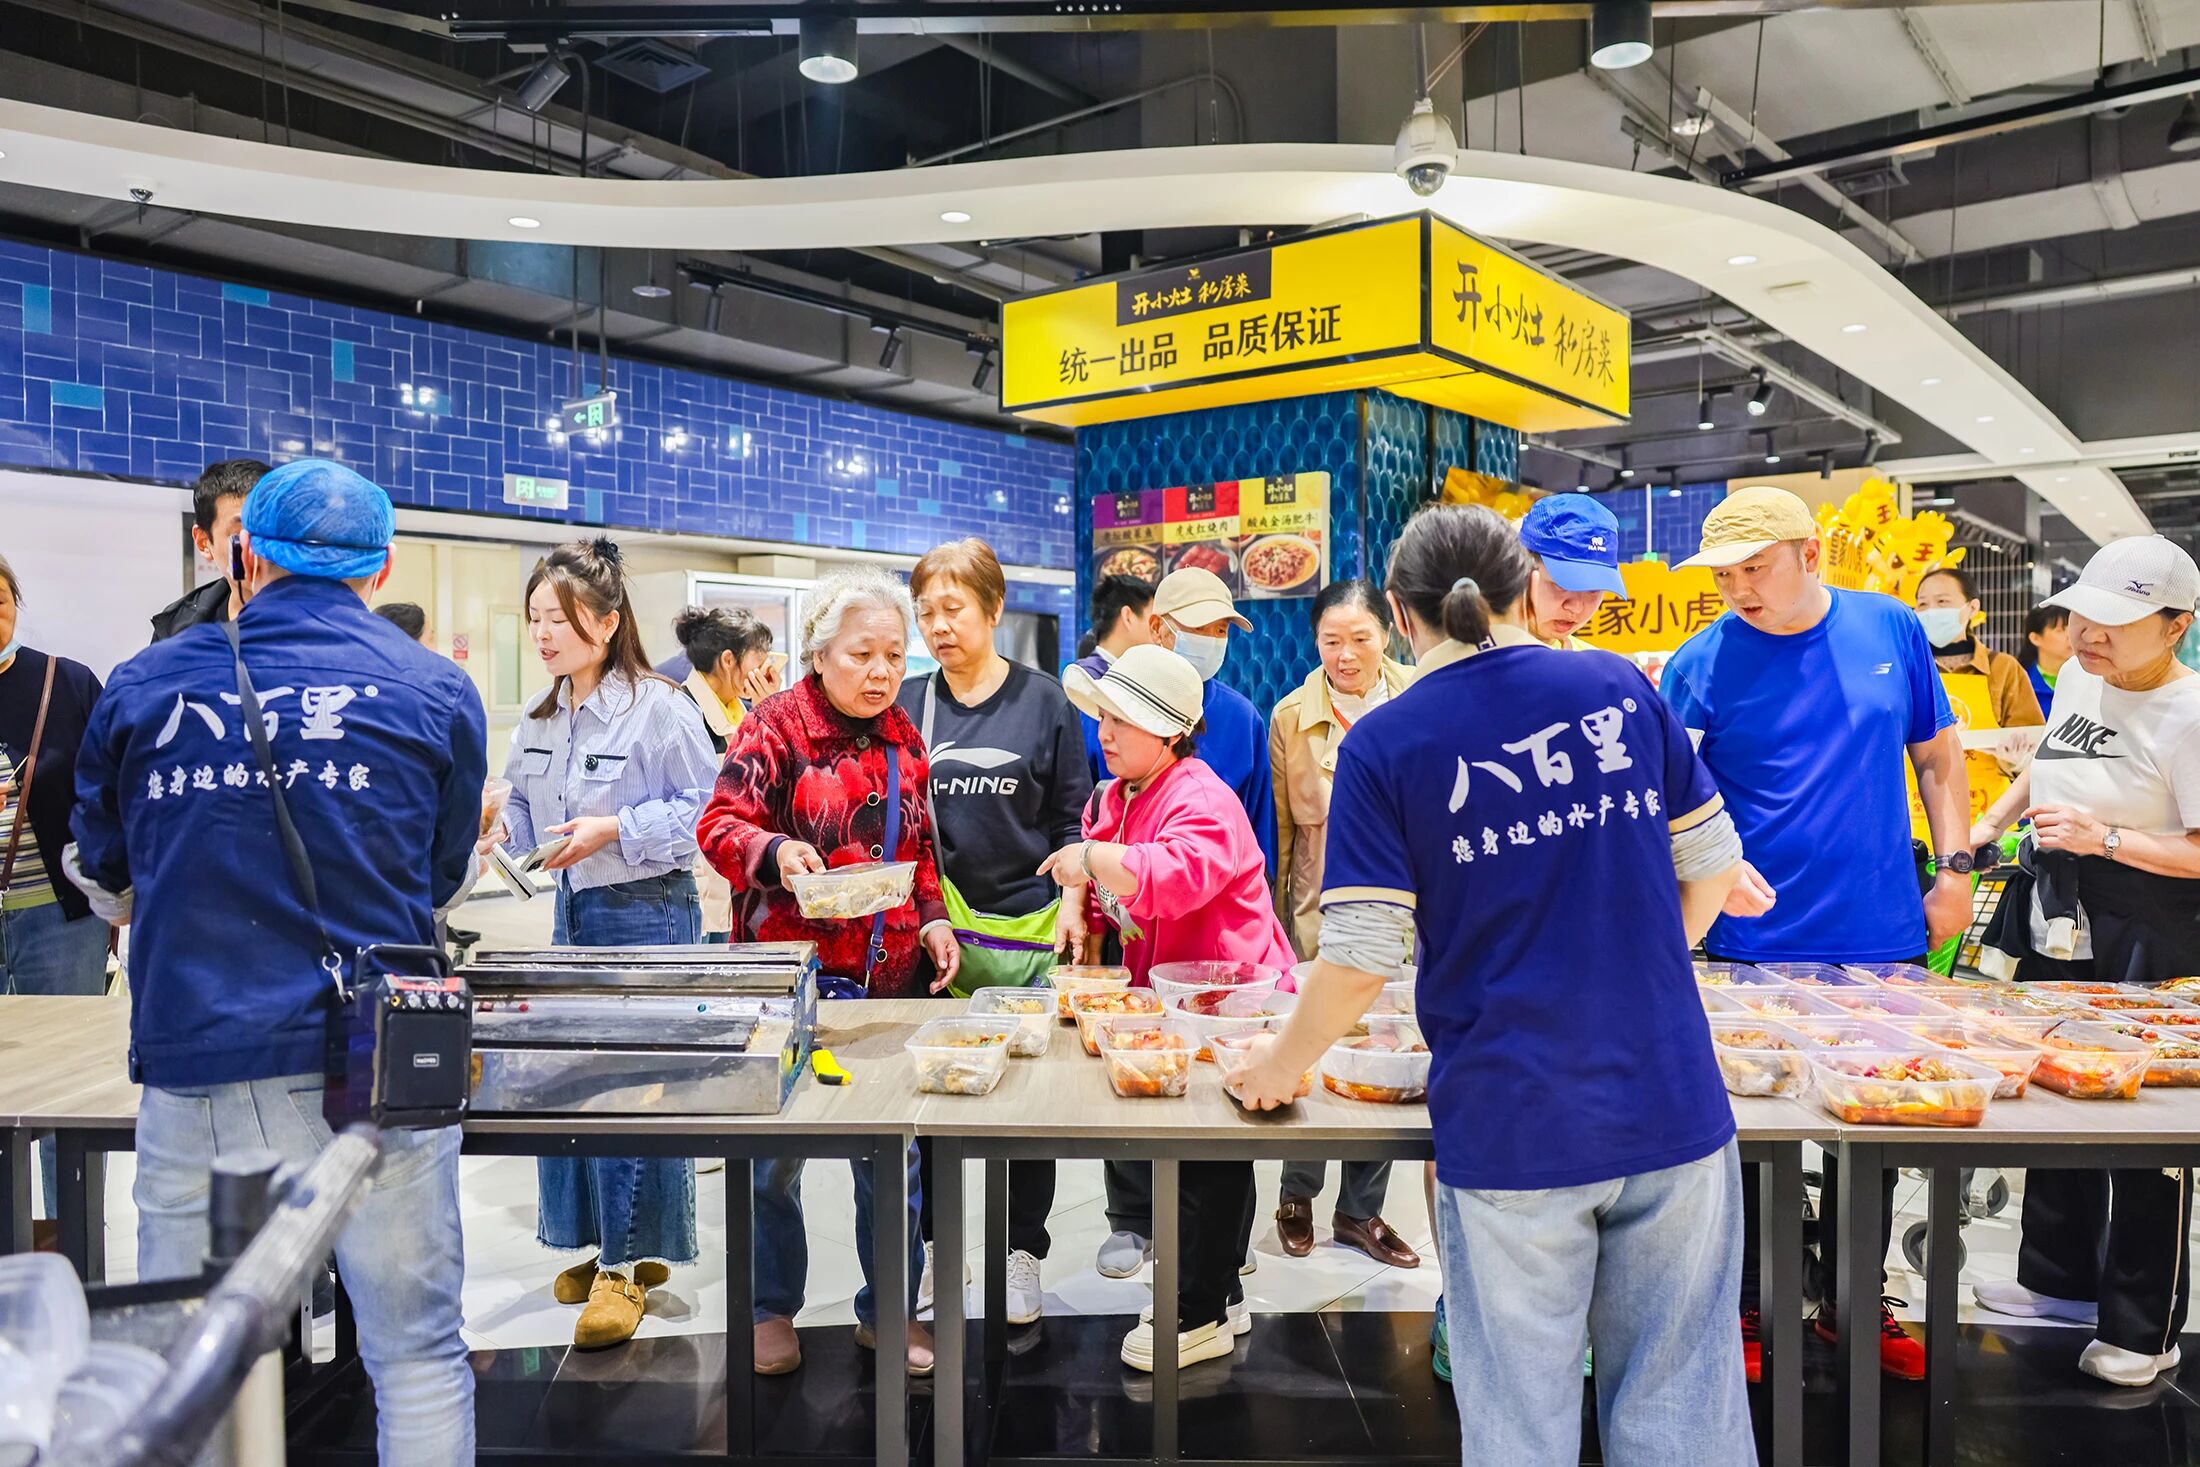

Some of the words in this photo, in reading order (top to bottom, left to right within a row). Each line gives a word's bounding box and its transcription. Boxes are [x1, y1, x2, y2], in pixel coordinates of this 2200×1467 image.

[1131, 287, 1193, 316] 开小灶
[1197, 272, 1252, 304] 私房菜
[1453, 257, 1545, 347] 开小灶
[1554, 313, 1615, 387] 私房菜
[1058, 331, 1178, 386] 统一出品
[1203, 303, 1342, 363] 品质保证
[1448, 705, 1634, 814] 八百里
[2053, 712, 2118, 753] NIKE
[930, 776, 1019, 796] I-NING
[1452, 788, 1662, 864] 您身边的水产专家
